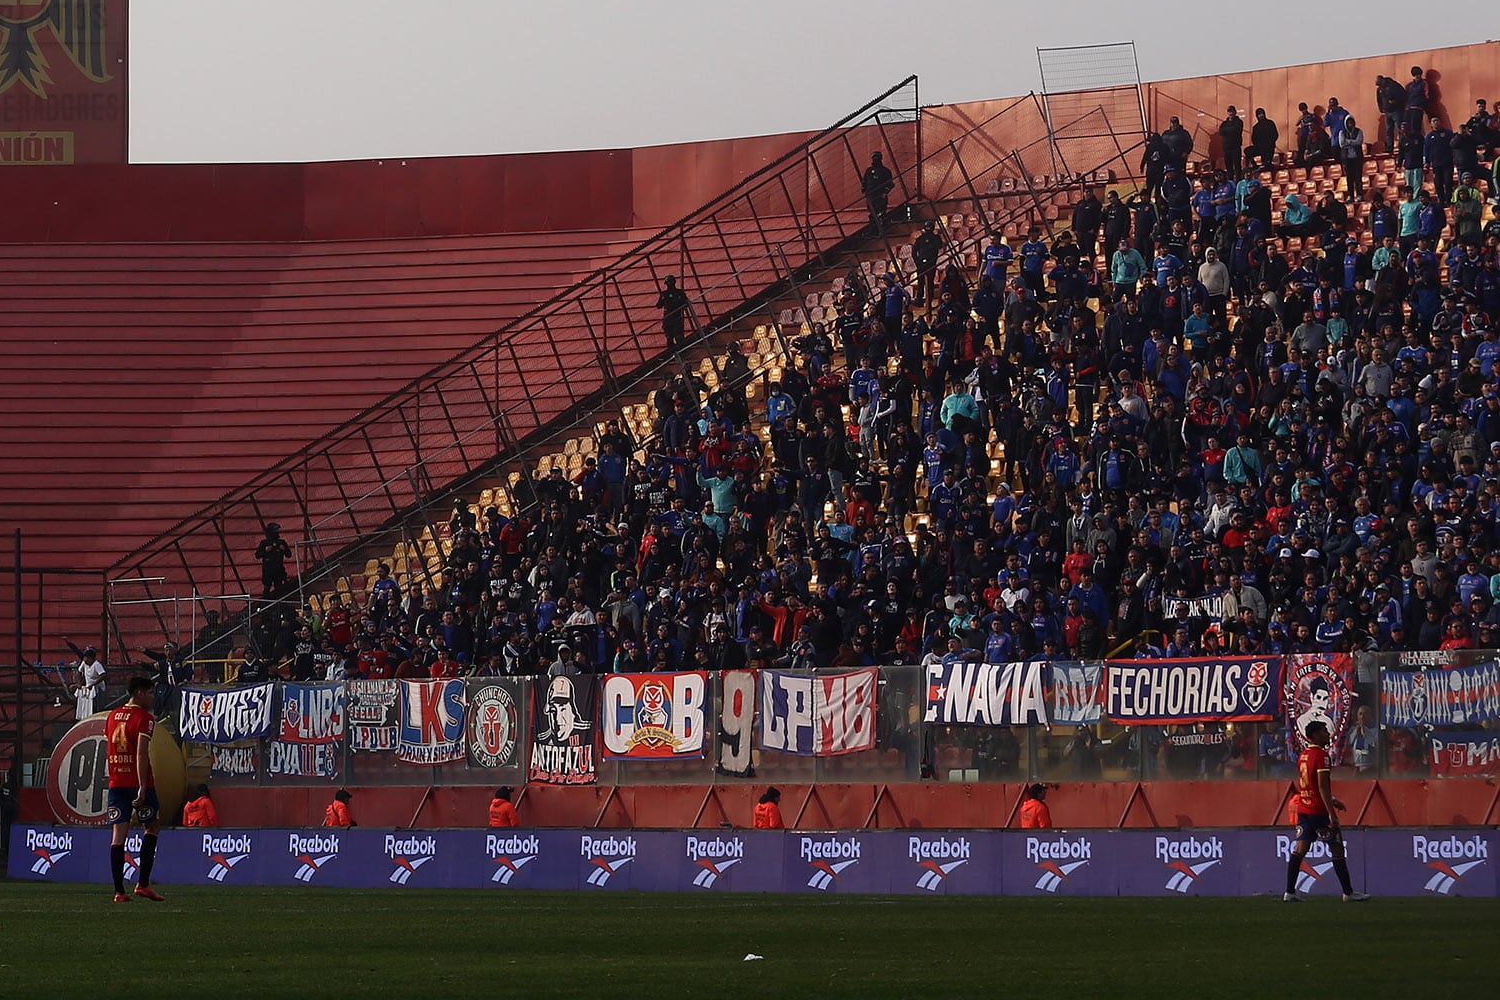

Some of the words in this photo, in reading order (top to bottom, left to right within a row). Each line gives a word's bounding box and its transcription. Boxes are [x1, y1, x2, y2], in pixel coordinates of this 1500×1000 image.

[944, 662, 1049, 725] NAVIA
[1107, 664, 1241, 716] FECHORIAS
[401, 680, 465, 745] LKS
[109, 754, 133, 764] SCORE
[530, 742, 594, 775] ANTOFAZUL
[26, 829, 73, 851] Reebok
[202, 834, 251, 857] Reebok
[289, 833, 339, 857] Reebok
[385, 835, 436, 859] Reebok
[486, 834, 540, 859] Reebok
[580, 835, 637, 860] Reebok
[686, 836, 744, 861] Reebok
[800, 837, 861, 863] Reebok
[908, 836, 971, 863] Reebok
[1026, 837, 1091, 864] Reebok
[1155, 836, 1223, 864] Reebok
[1413, 835, 1488, 863] Reebok
